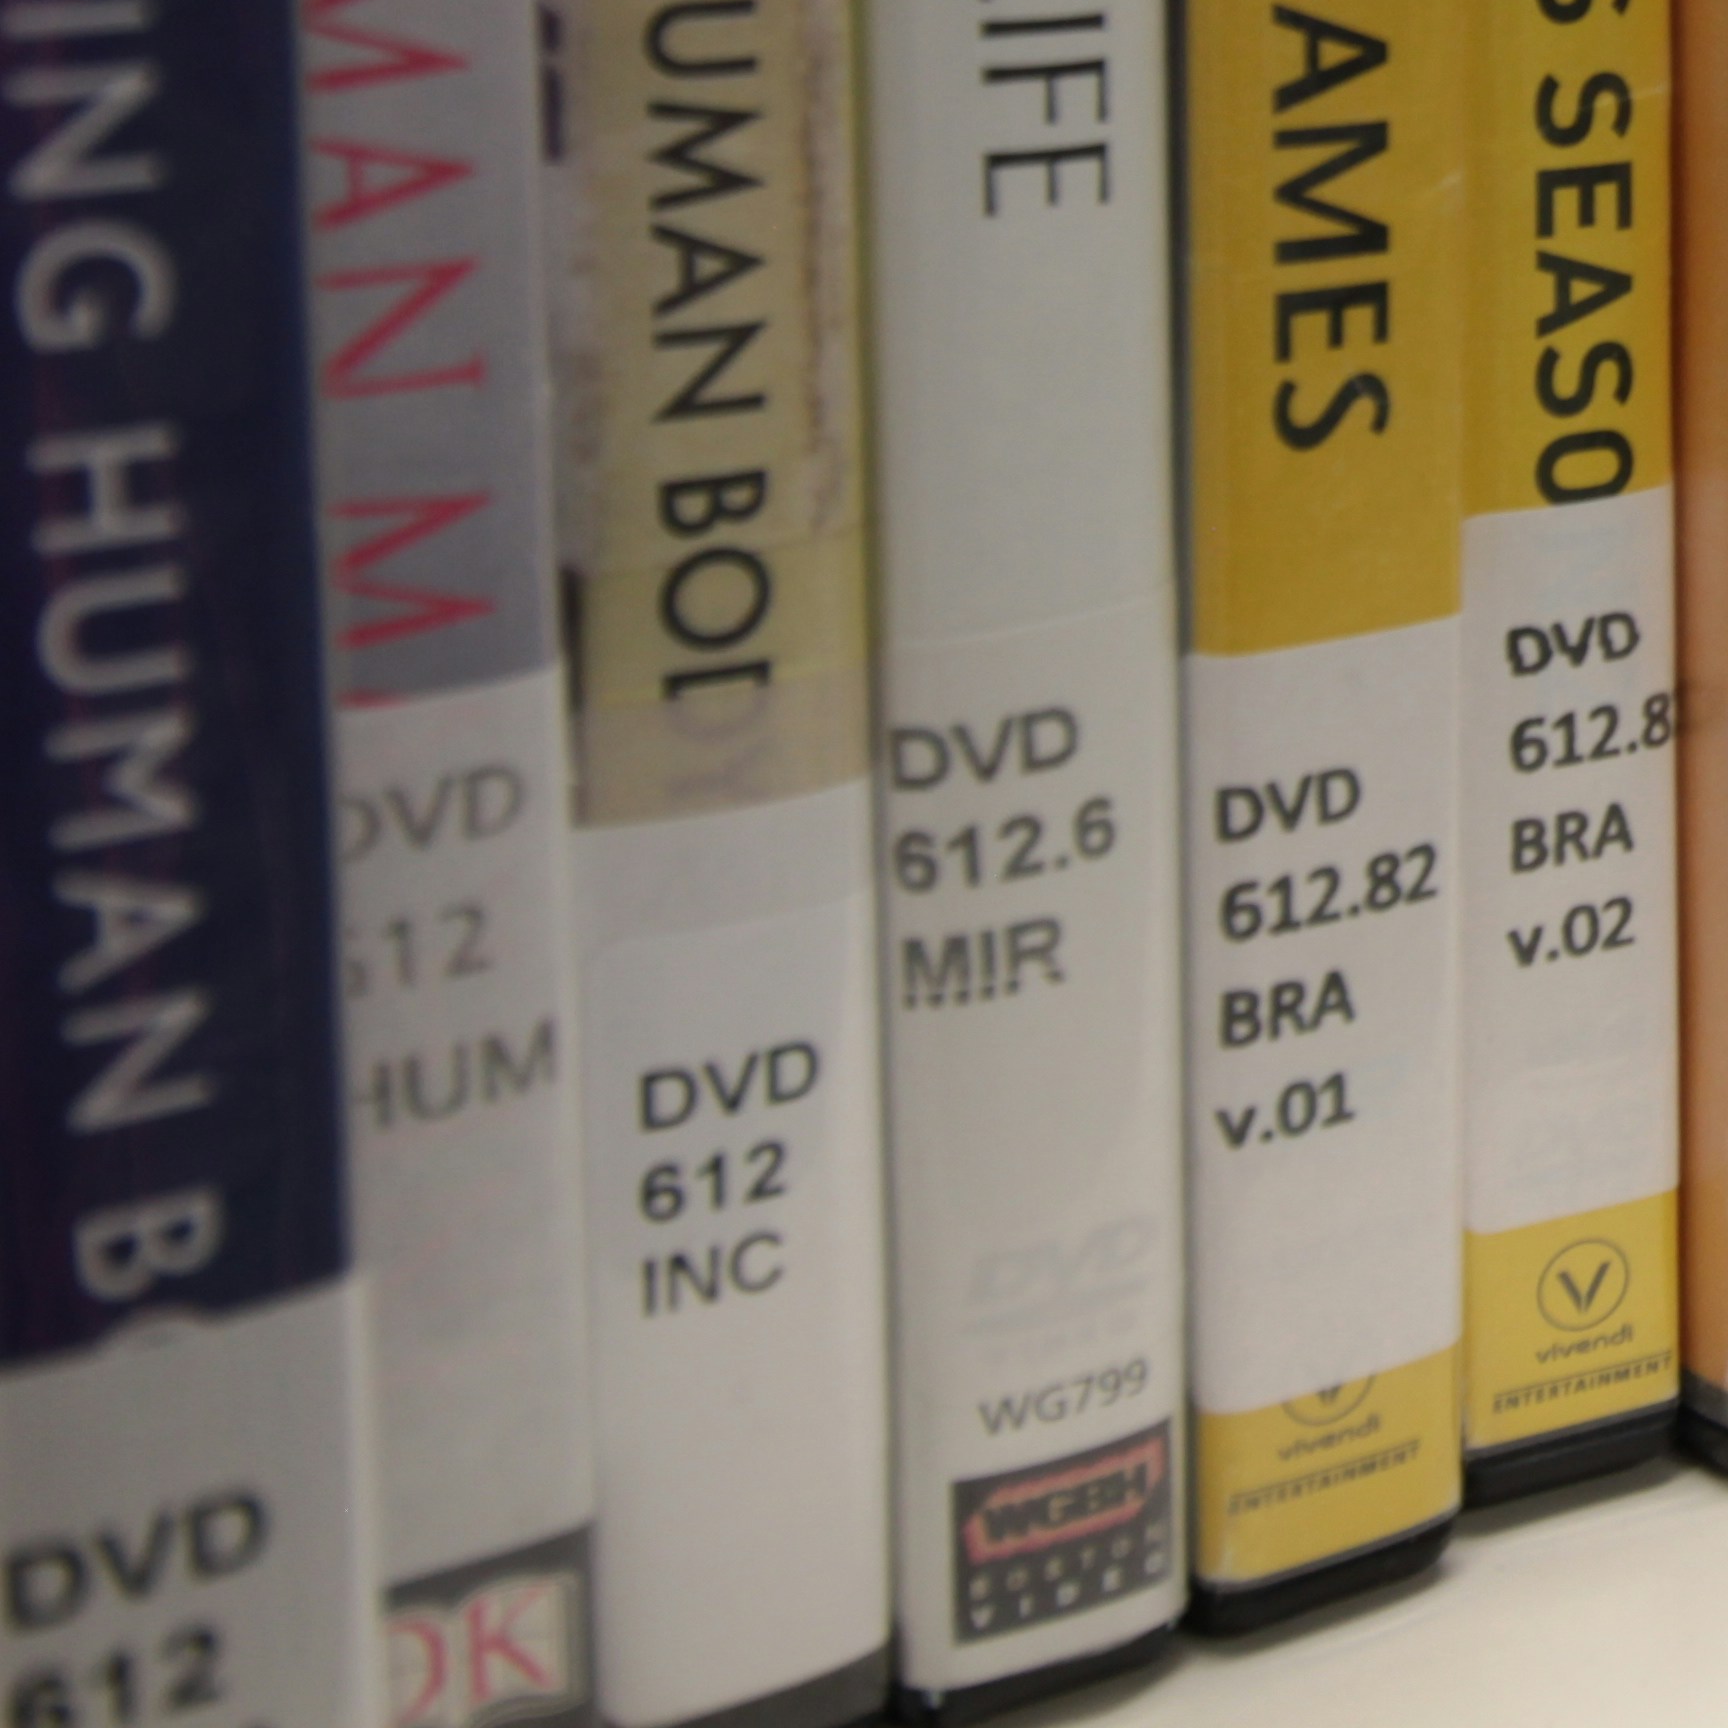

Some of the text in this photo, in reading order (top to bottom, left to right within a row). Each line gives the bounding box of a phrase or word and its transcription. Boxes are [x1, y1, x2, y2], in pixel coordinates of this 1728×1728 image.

[1505, 611, 1642, 675] DVD
[28, 420, 214, 1136] HUMAN
[889, 705, 1081, 793] DVD
[892, 797, 1117, 893] 612.6
[1216, 766, 1362, 845] DVD
[1509, 803, 1635, 876] BRA
[1220, 842, 1440, 944] 612.82
[1507, 896, 1638, 970] v.02
[1219, 969, 1357, 1051] BRA
[639, 1040, 819, 1133] DVD
[1214, 1071, 1355, 1152] v.01
[640, 1139, 788, 1225] 612
[640, 1230, 785, 1319] INC
[1492, 1351, 1675, 1416] ENTERTAINMENT
[1535, 1321, 1637, 1366] vivendi
[977, 1357, 1151, 1439] WG799
[1275, 1412, 1382, 1467] vivendi
[4, 1492, 270, 1636] DVD
[970, 1550, 1167, 1629] VIDEO
